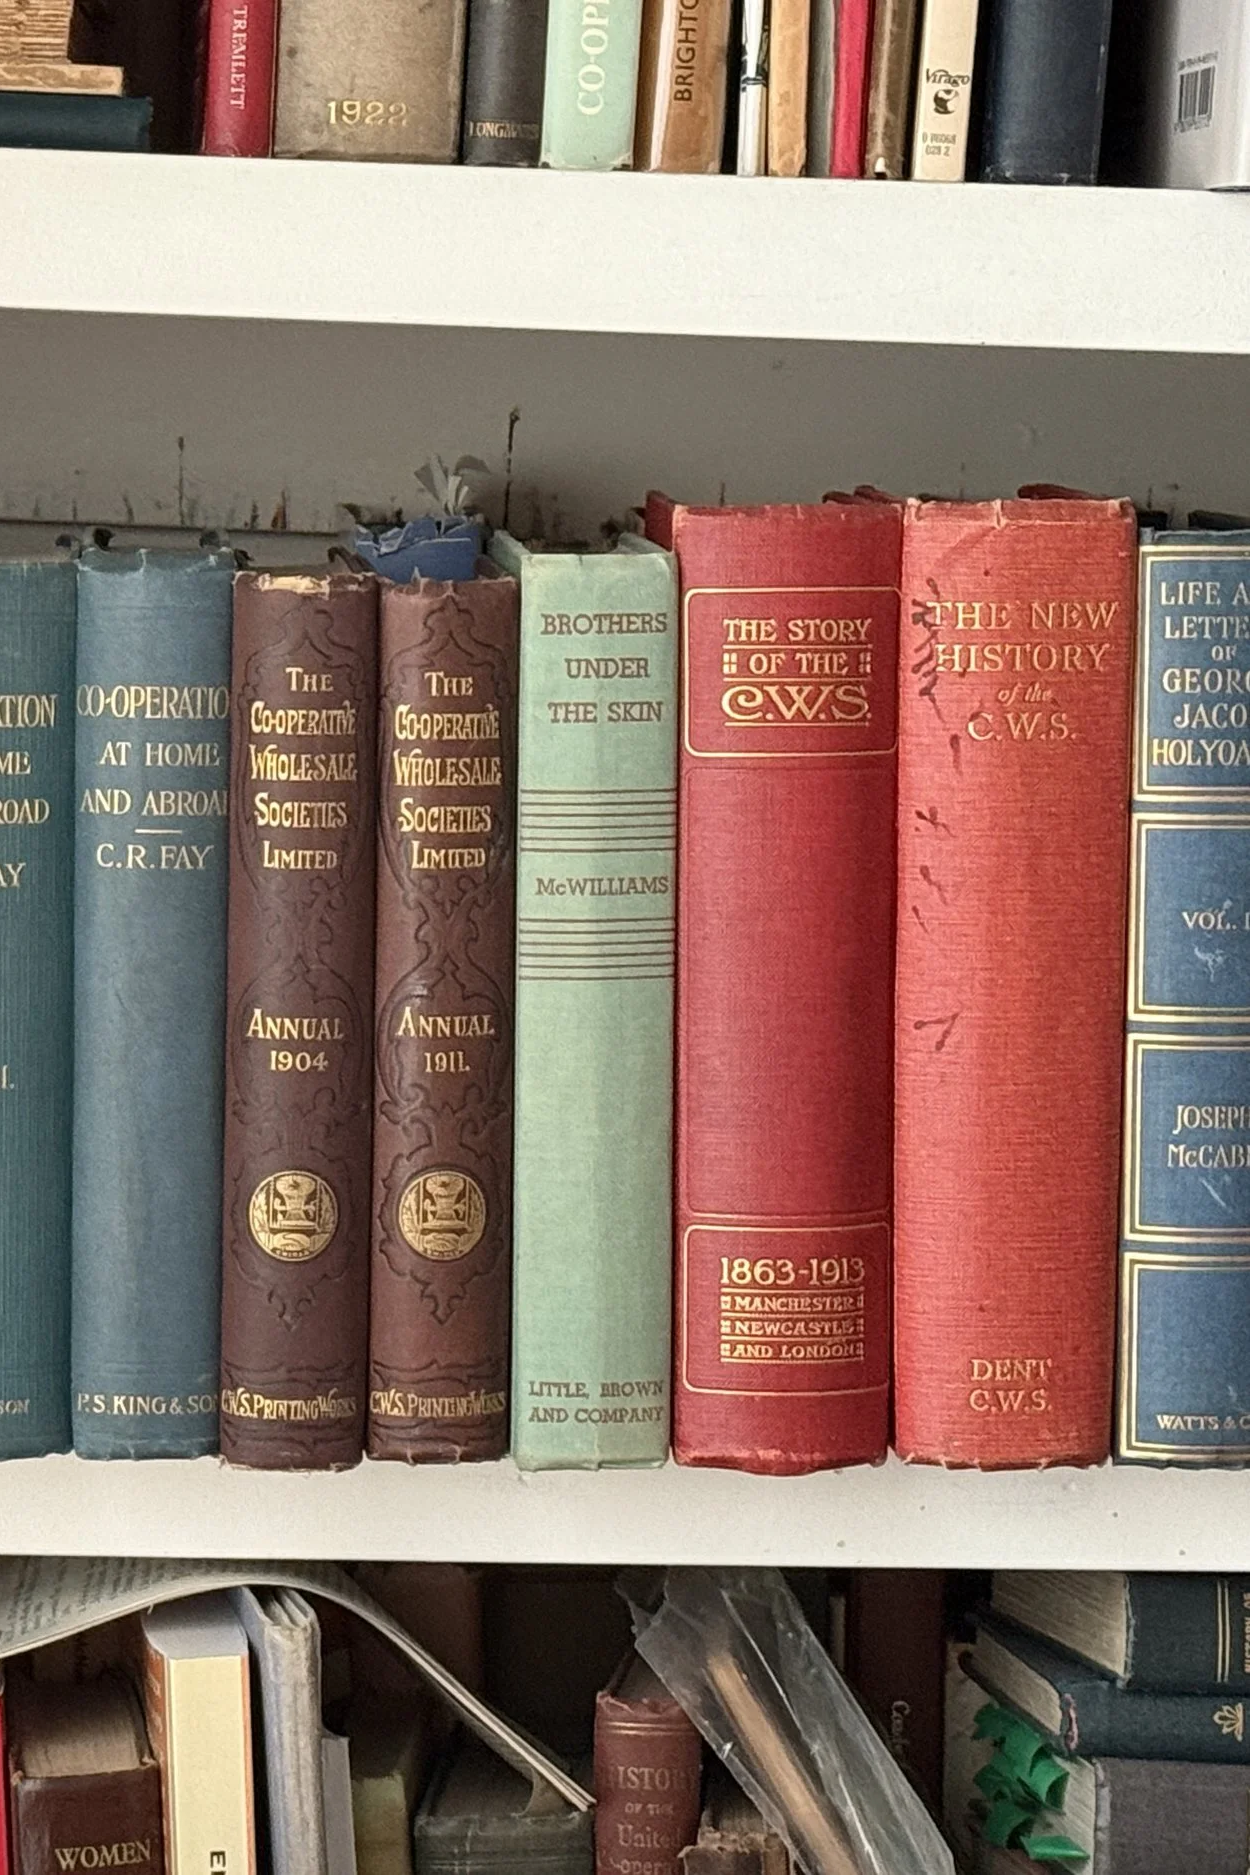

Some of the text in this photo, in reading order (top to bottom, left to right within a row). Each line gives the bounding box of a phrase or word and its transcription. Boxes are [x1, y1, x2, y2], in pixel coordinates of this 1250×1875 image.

[230, 5, 248, 110] TREMLETT
[926, 68, 970, 87] Virago
[326, 100, 408, 127] 1922
[1160, 581, 1222, 606] LIFE
[540, 612, 668, 636] BROTHERS
[925, 600, 1120, 630] THE NEW
[722, 618, 873, 643] THE STORY
[749, 652, 849, 676] OF THE
[934, 642, 1112, 673] HISTORY
[1211, 644, 1237, 662] OF
[564, 657, 650, 679] UNDER
[998, 681, 1052, 707] of the
[547, 700, 664, 724] THE SKIN
[967, 711, 1077, 741] C.W.S.
[98, 741, 220, 767] AT HOME
[79, 788, 132, 816] AND
[535, 875, 670, 897] McWILLIAMS
[1182, 911, 1237, 931] VOL.
[270, 1050, 329, 1072] 1904
[720, 1256, 866, 1286] 1863-1913
[733, 1296, 856, 1313] MANCHESTER
[734, 1320, 855, 1336] NEWCASTLE
[731, 1343, 856, 1359] AND LONDON
[970, 1358, 1053, 1382] DENT
[528, 1379, 664, 1399] LITTLE, BROWN
[969, 1388, 1053, 1413] C.W.S.
[528, 1406, 664, 1424] AND COMPANY
[1156, 1414, 1219, 1431] WATTS
[1223, 1416, 1237, 1429] &
[55, 1838, 152, 1872] WOMEN
